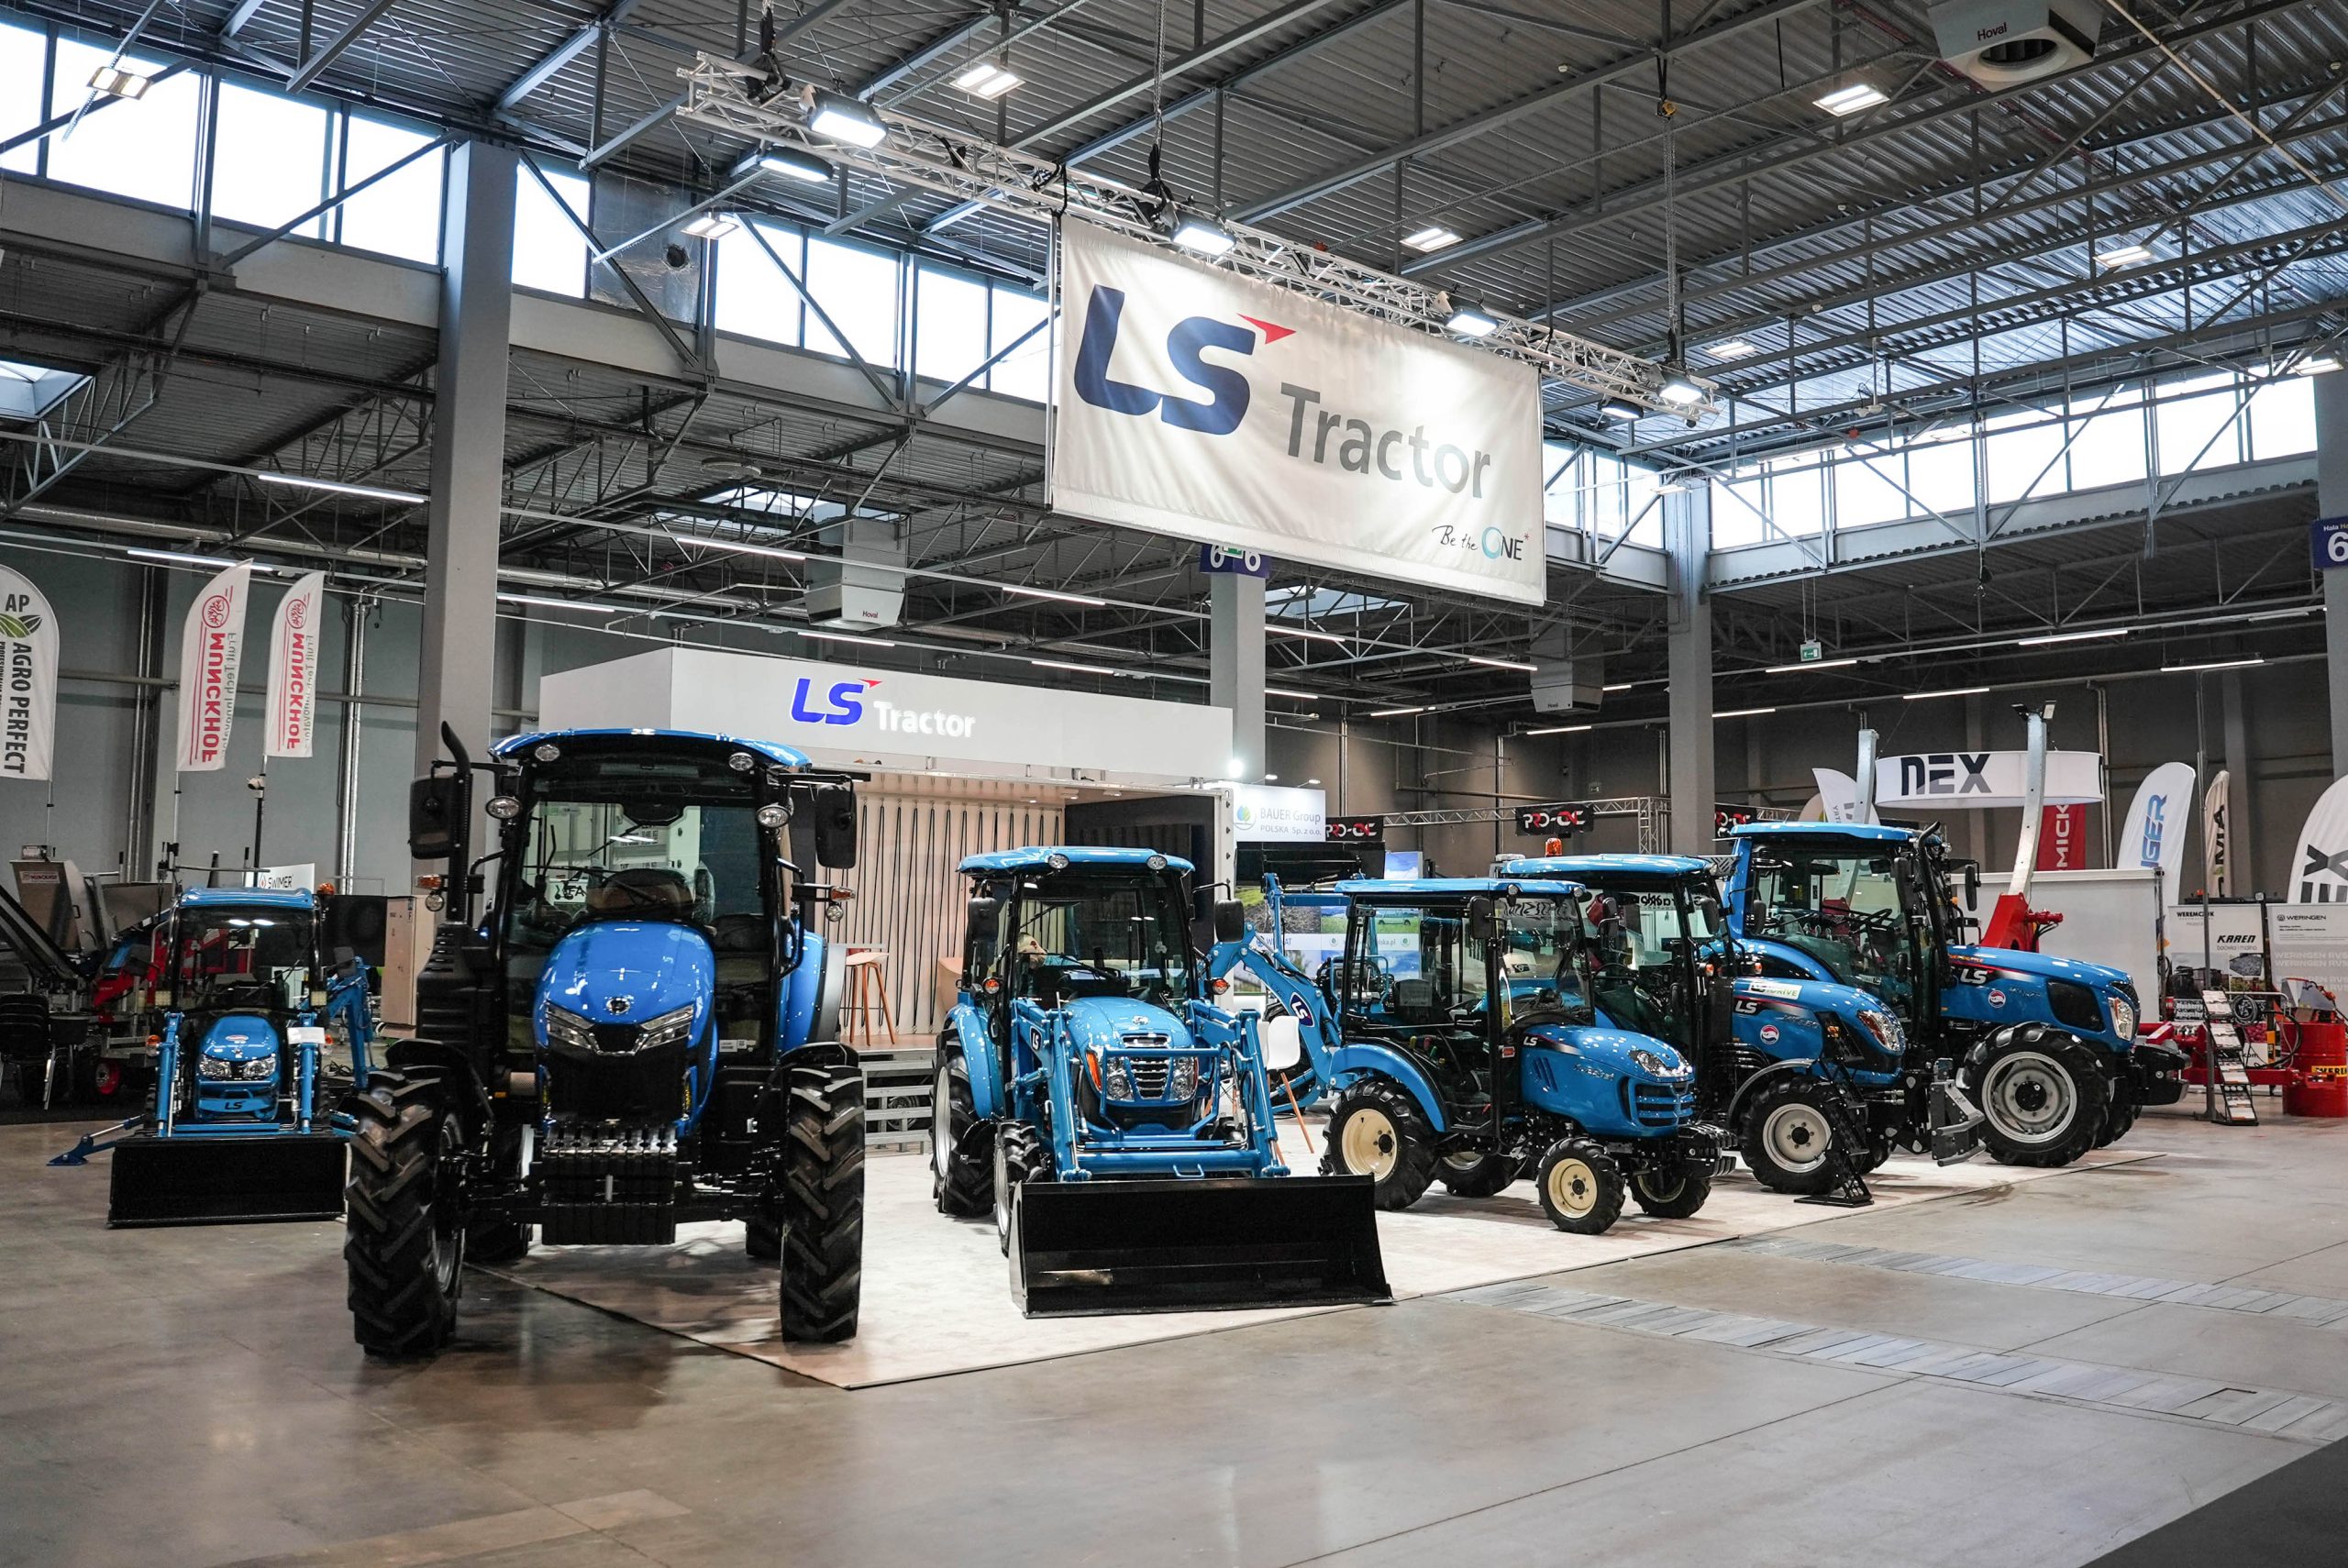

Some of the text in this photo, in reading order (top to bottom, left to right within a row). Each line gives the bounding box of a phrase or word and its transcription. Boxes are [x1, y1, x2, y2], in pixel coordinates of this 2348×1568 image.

[1977, 22, 2008, 41] Hoval
[1074, 284, 1491, 499] LS Tractor
[1432, 525, 1456, 546] Be
[1461, 534, 1479, 551] the
[6, 593, 30, 613] AP
[862, 610, 879, 619] Hoval
[4, 642, 32, 774] AGRO PERFECT
[790, 677, 977, 738] LS Tractor
[1900, 753, 1992, 797] NEX
[1260, 807, 1322, 824] BAUER Group
[1260, 824, 1290, 834] POLSKA
[1291, 826, 1303, 835] Sp.
[2217, 934, 2256, 944] KAREN
[1959, 967, 1988, 985] LS
[1291, 1000, 1309, 1020] LS
[1734, 999, 1758, 1014] LS
[1032, 1032, 1040, 1050] LS
[1523, 1035, 1539, 1046] LS
[225, 1101, 243, 1110] LS
